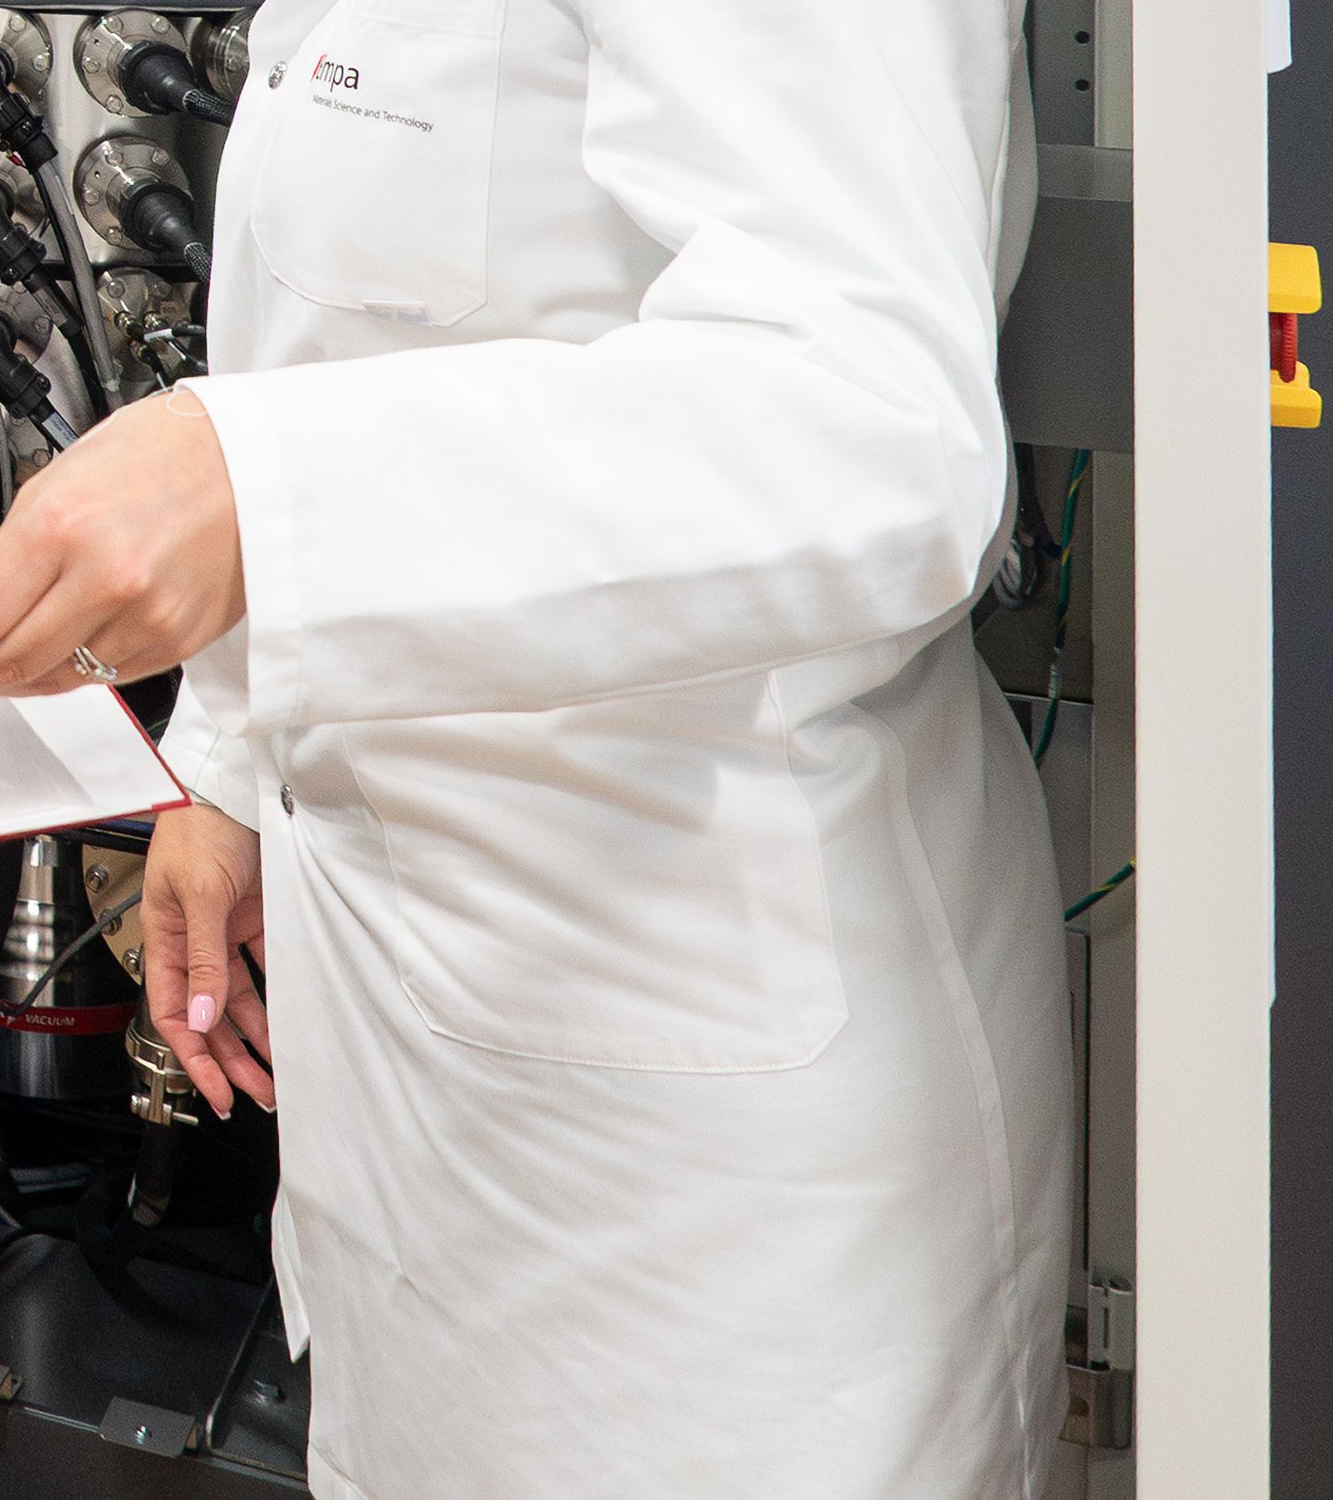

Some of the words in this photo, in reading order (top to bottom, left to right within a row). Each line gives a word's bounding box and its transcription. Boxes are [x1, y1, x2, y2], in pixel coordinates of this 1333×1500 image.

[333, 99, 362, 116] Science
[364, 108, 380, 119] and
[383, 111, 434, 132] Technology
[25, 1014, 75, 1026] VACUUM
